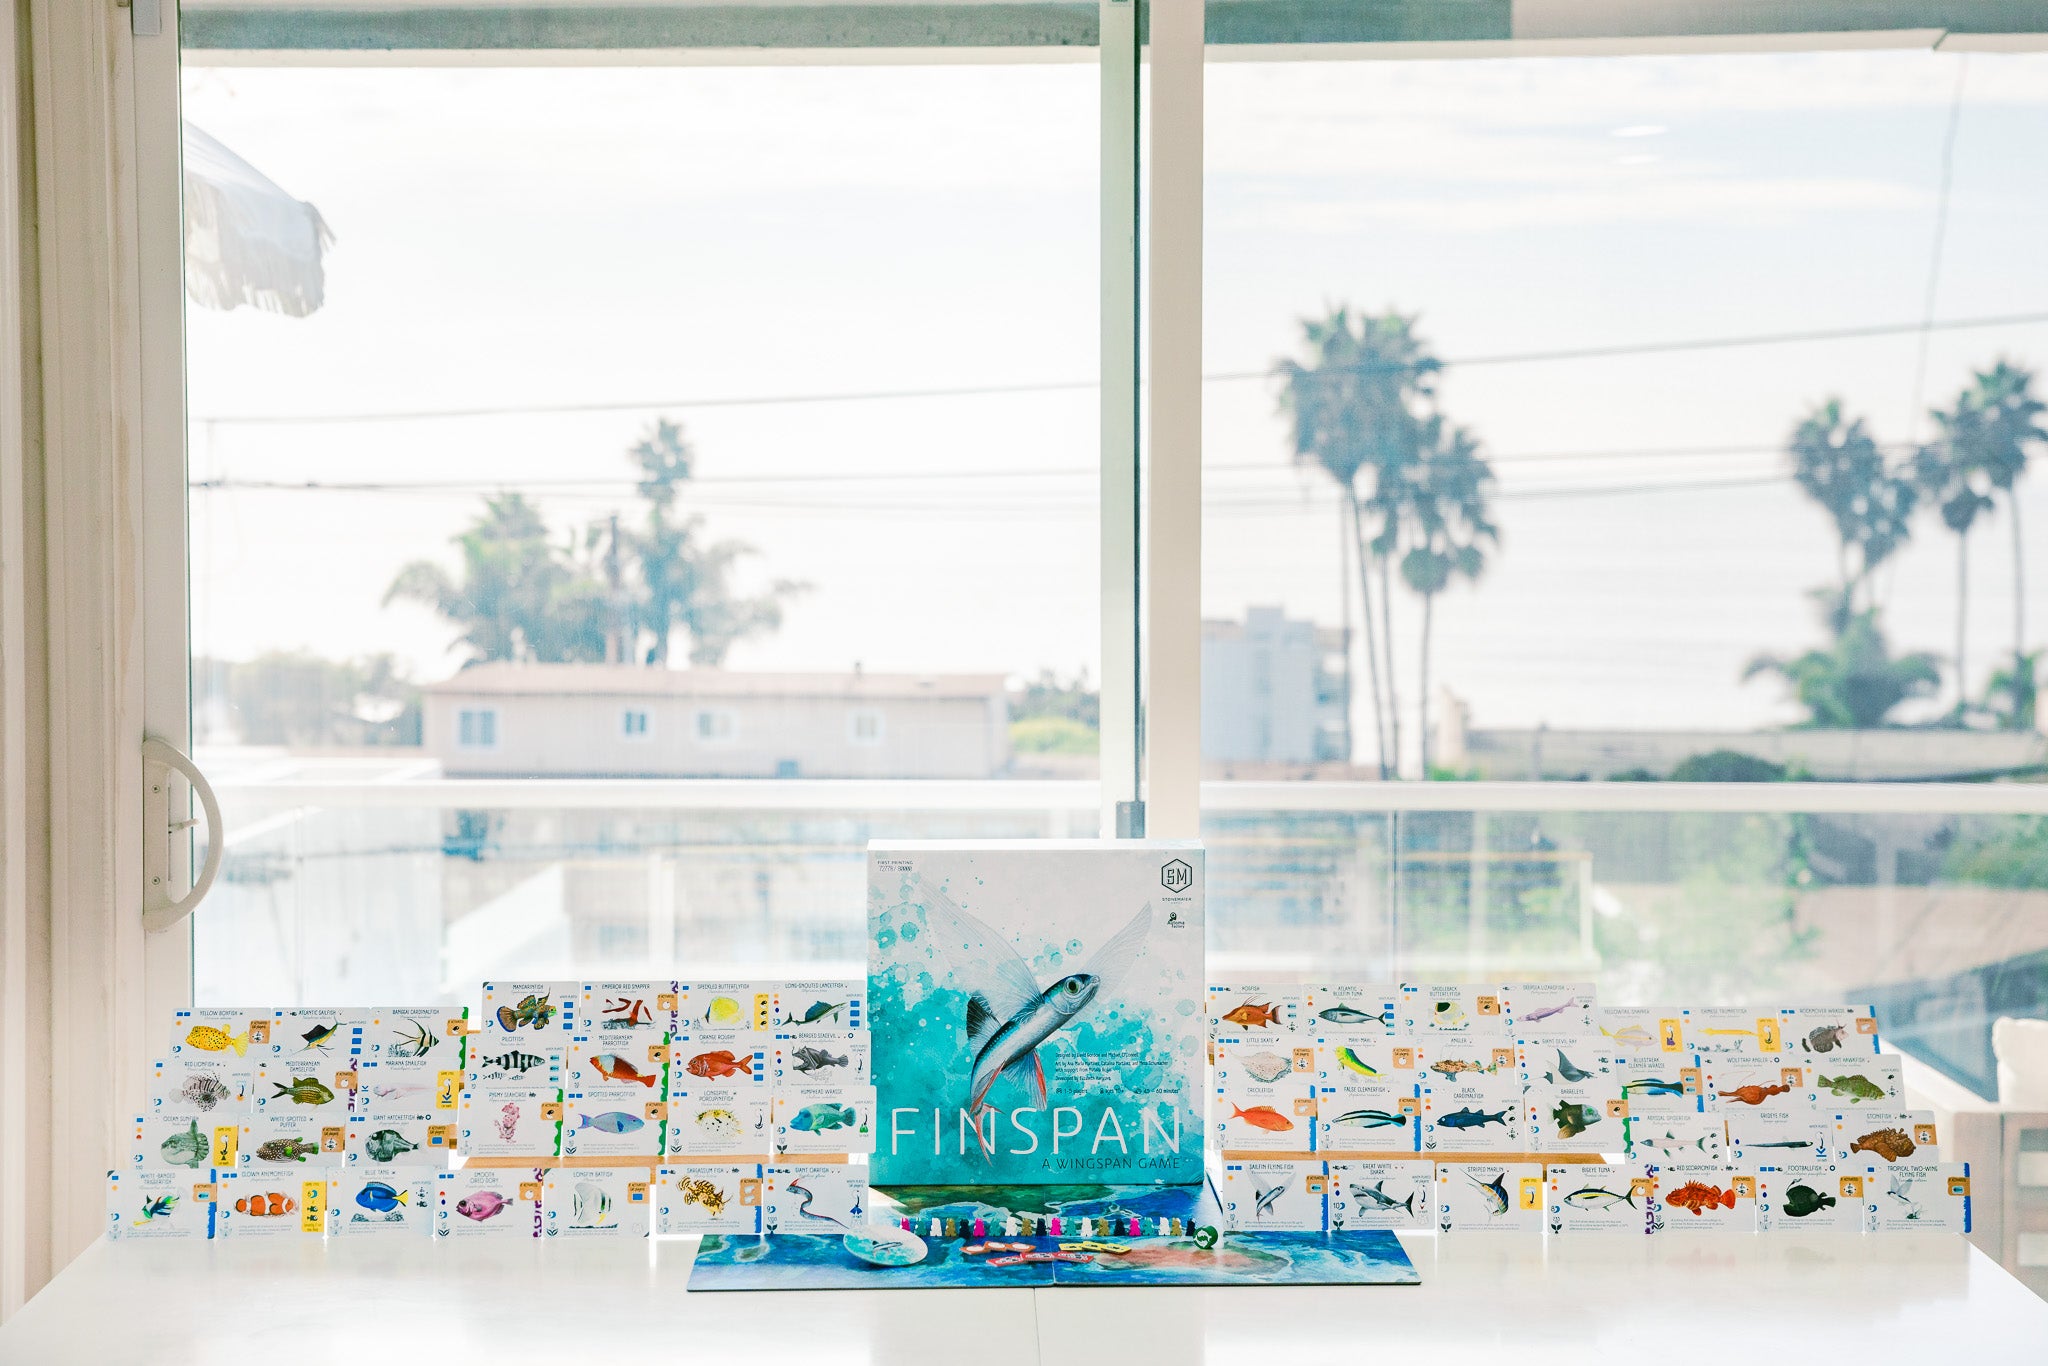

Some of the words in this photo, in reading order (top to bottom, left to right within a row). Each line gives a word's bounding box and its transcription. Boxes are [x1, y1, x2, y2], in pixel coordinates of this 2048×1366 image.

[1167, 868, 1187, 885] SM
[891, 1106, 1180, 1156] FINSPAN
[1042, 1158, 1051, 1169] A
[1056, 1158, 1132, 1169] WINGSPAN
[1138, 1158, 1180, 1169] GAME
